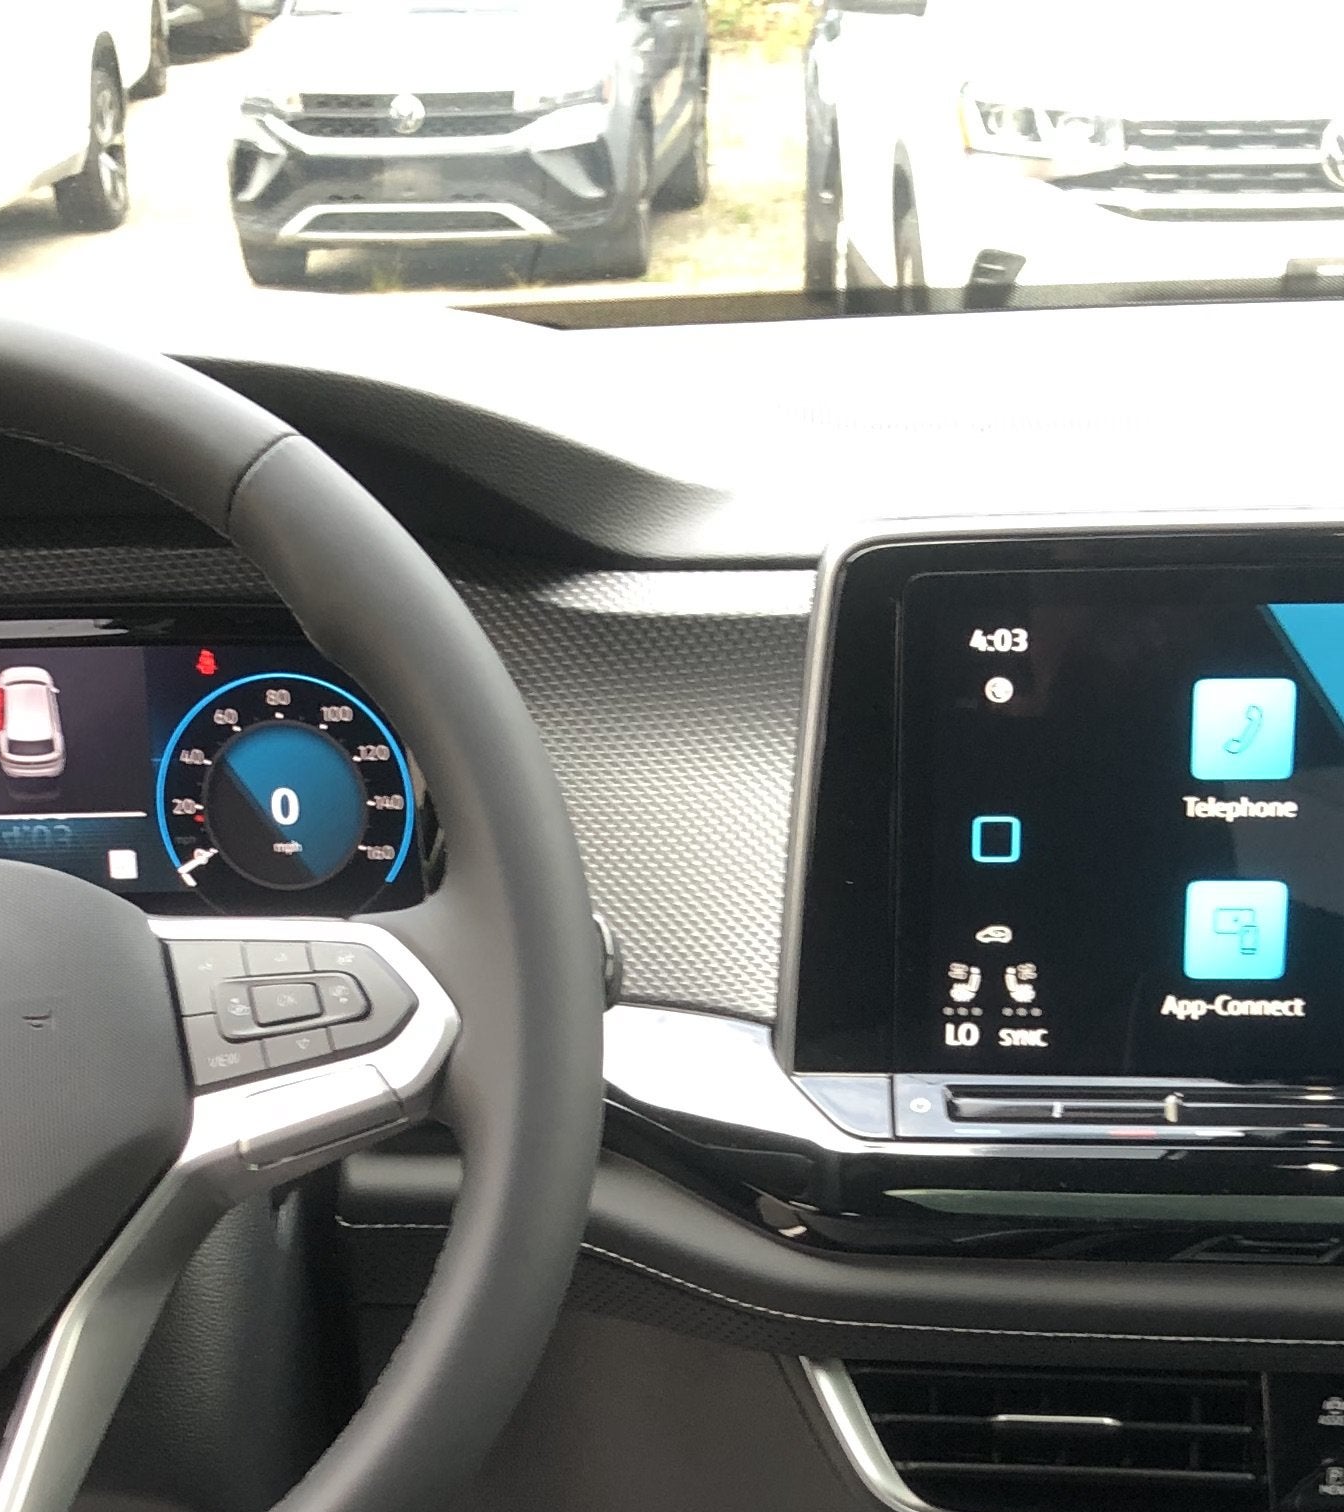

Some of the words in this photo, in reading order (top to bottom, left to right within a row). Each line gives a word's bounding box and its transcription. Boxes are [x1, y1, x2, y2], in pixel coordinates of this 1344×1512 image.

[970, 627, 1029, 654] 4:03
[265, 688, 292, 706] 80
[319, 705, 354, 722] 100
[178, 748, 206, 766] 40
[356, 744, 391, 761] 120
[171, 797, 198, 816] 20
[270, 787, 301, 826] 0
[372, 794, 405, 811] 140
[1182, 796, 1298, 822] Telephone
[1160, 994, 1306, 1019] App-Connect
[944, 1021, 981, 1047] LO
[998, 1027, 1050, 1048] SYNC
